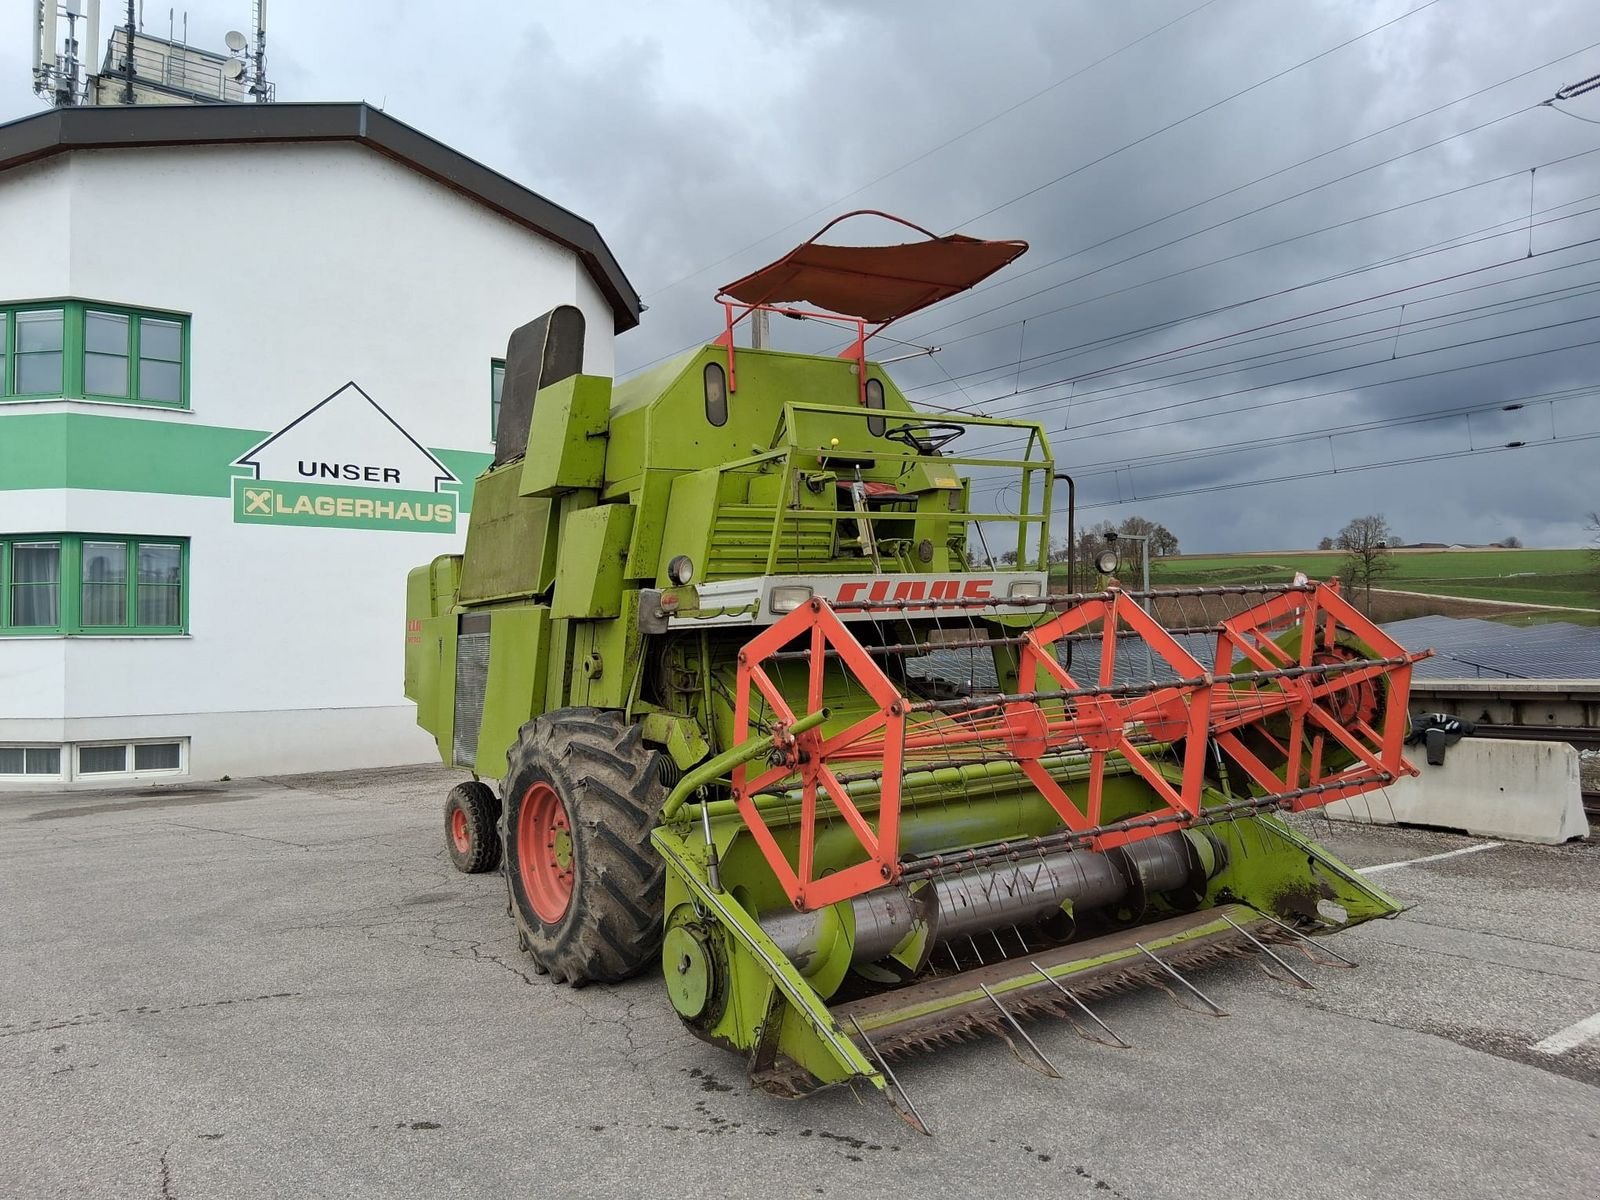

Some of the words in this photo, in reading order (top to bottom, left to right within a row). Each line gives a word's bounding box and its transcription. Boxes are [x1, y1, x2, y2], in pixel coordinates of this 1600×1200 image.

[298, 460, 401, 484] UNSER
[276, 494, 453, 523] LAGERHAUS
[834, 579, 994, 614] CLAAS
